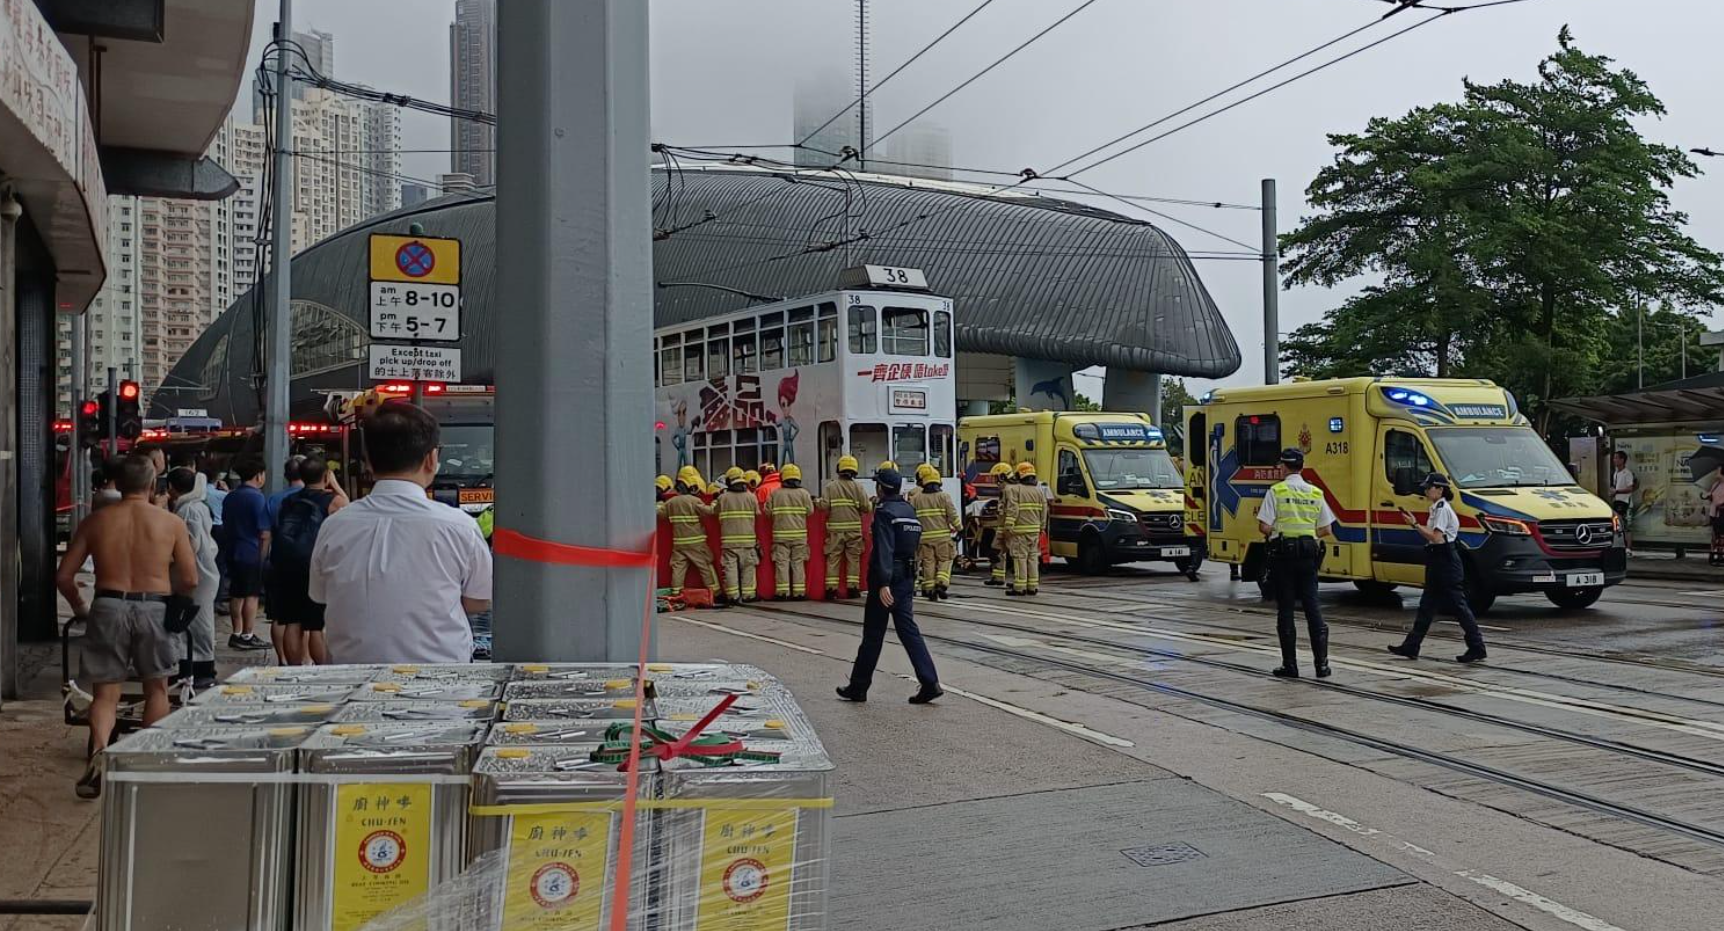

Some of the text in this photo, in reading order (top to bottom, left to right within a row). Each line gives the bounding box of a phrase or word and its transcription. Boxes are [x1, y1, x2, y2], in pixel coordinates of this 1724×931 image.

[883, 268, 908, 284] 38
[376, 296, 402, 306] 上午
[406, 290, 454, 308] 8-10
[848, 294, 861, 304] 38
[380, 313, 396, 321] pm
[376, 322, 402, 333] 下午
[392, 348, 442, 358] Except taxi
[380, 356, 399, 365] pick
[402, 357, 437, 367] up/drop
[375, 366, 455, 379] 的士上落客除外
[1455, 406, 1504, 416] AMBULANCE
[1102, 428, 1145, 437] AMBULANCE
[1326, 442, 1348, 454] A318
[461, 492, 494, 501] SERVI
[1583, 575, 1596, 584] 318
